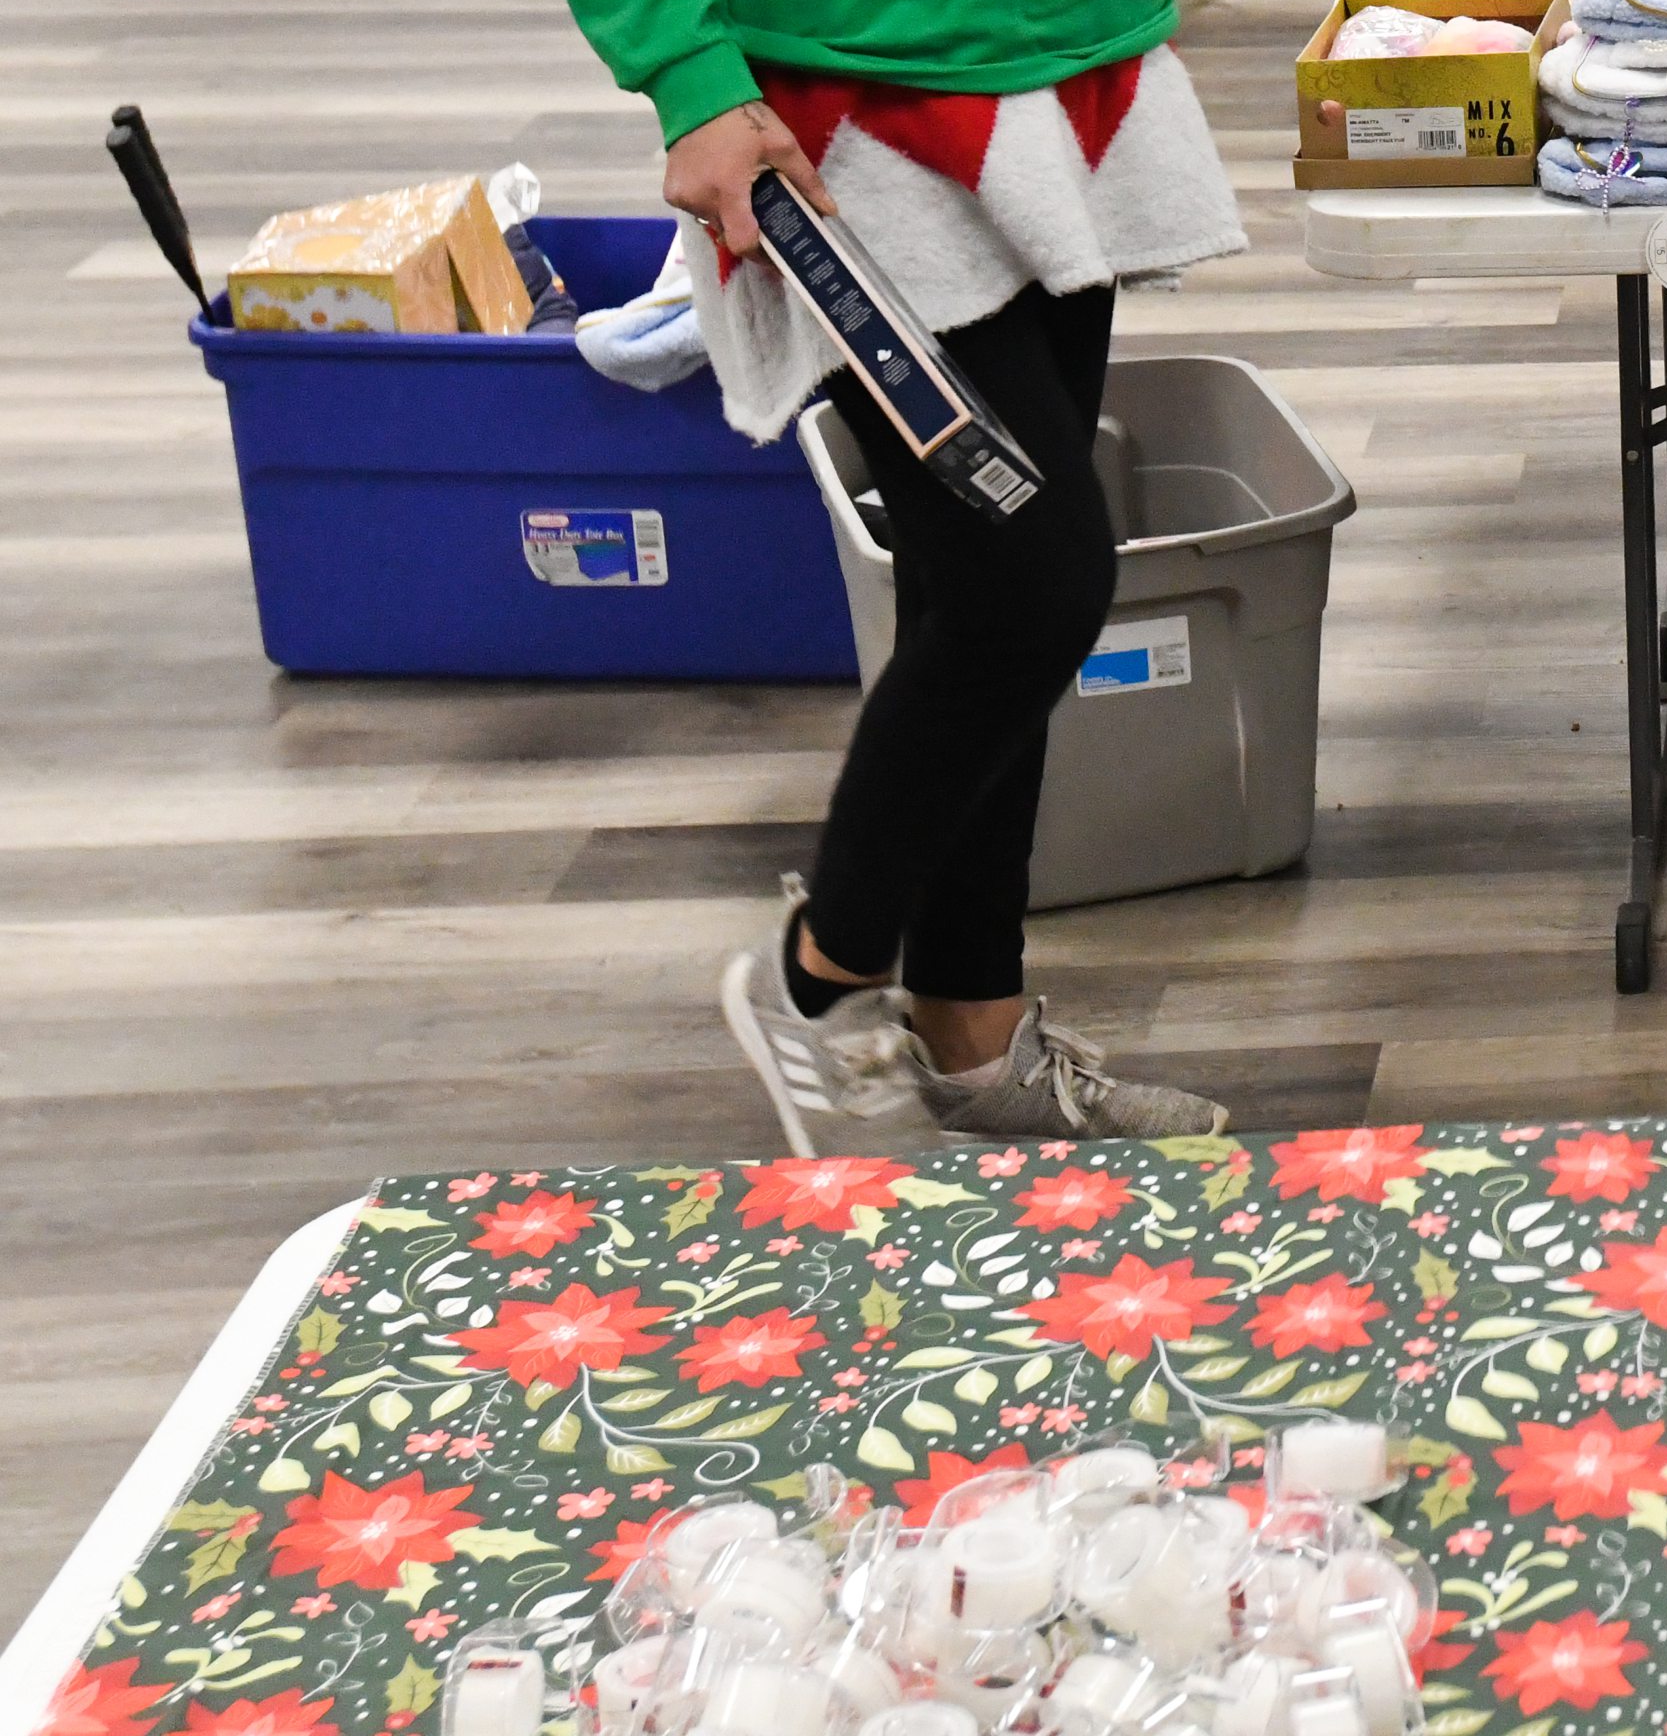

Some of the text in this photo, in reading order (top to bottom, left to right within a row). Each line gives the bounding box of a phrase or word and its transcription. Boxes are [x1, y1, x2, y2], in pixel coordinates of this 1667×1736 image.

[1468, 100, 1512, 120] MIX
[1469, 122, 1515, 156] NO. 6
